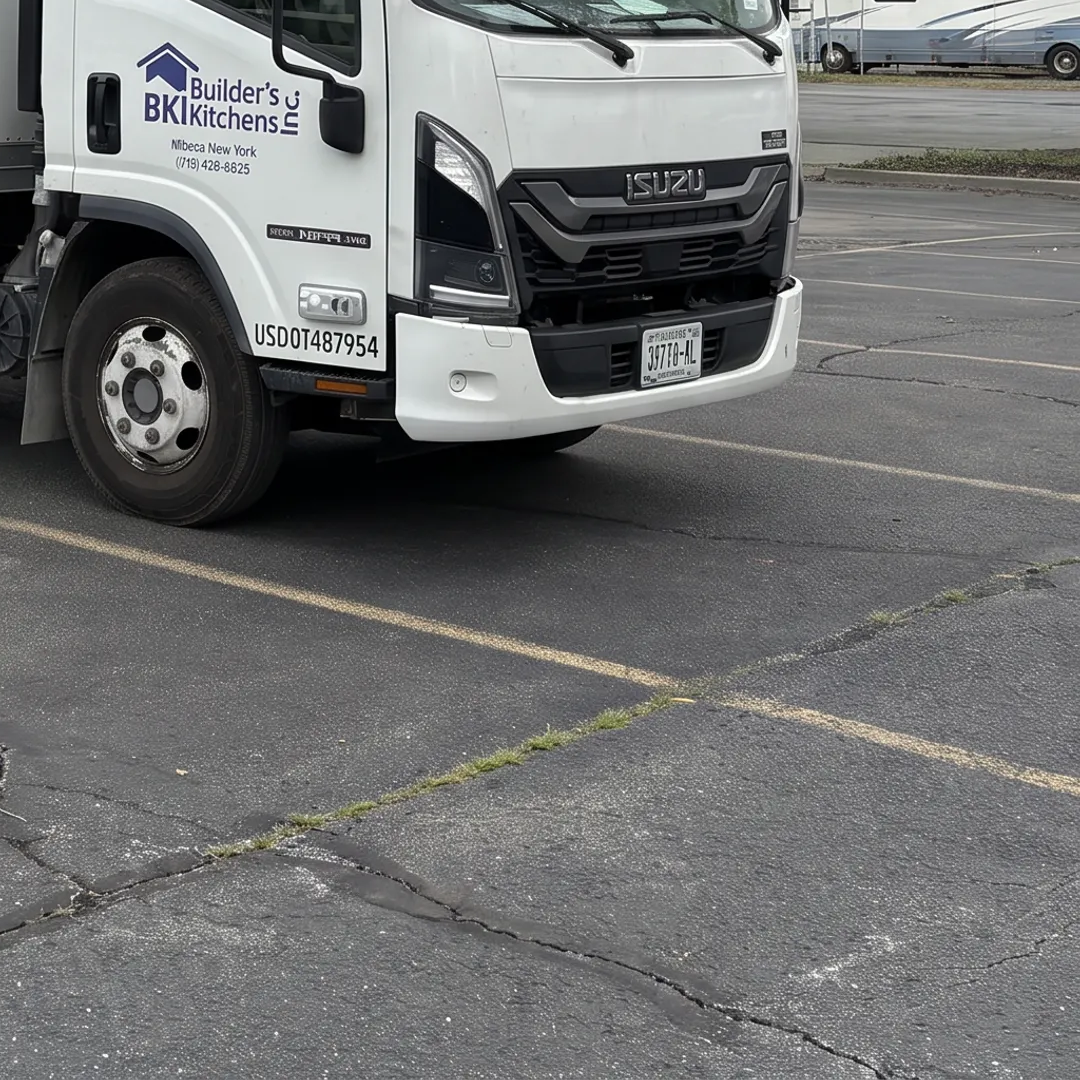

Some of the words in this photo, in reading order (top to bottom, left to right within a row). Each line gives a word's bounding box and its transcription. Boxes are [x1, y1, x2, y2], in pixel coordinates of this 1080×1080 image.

[191, 77, 280, 106] Builder's
[144, 92, 187, 126] BKI
[190, 103, 279, 134] Kitchens
[280, 90, 301, 136] Inc.
[208, 142, 231, 156] New
[233, 144, 257, 158] York
[626, 168, 705, 200] ISUZU
